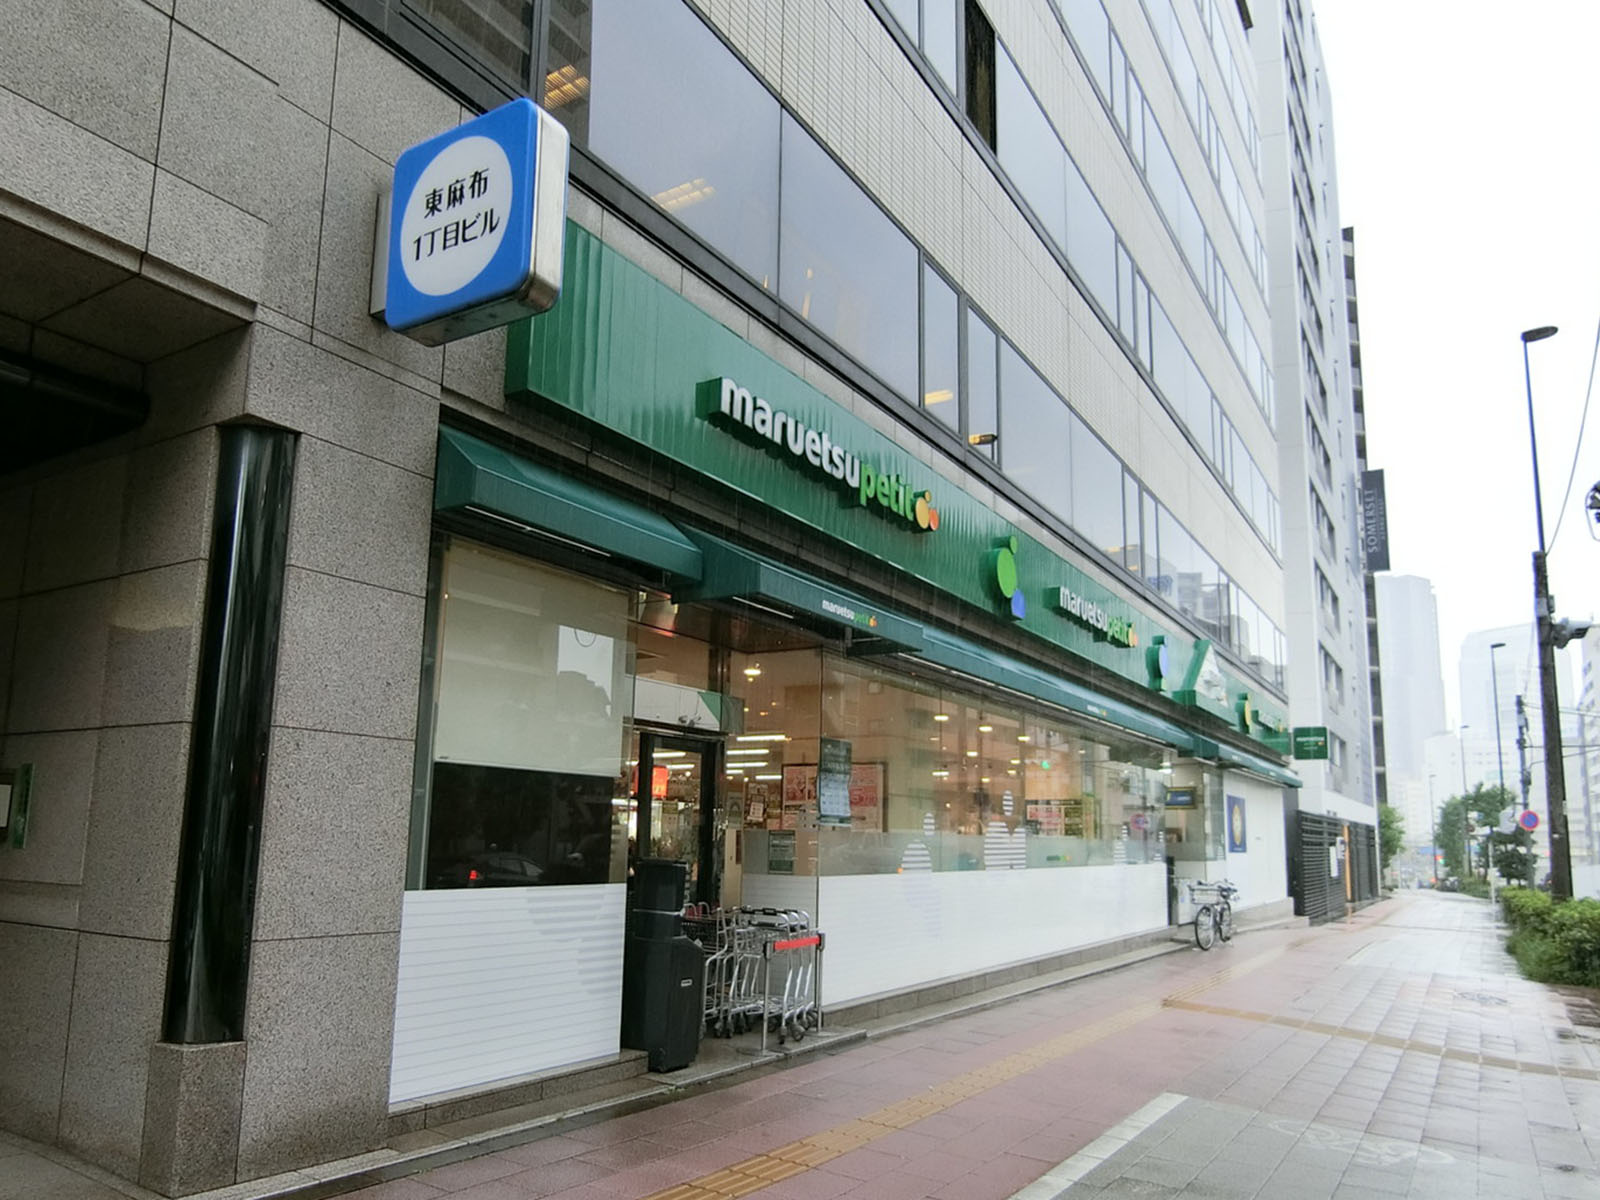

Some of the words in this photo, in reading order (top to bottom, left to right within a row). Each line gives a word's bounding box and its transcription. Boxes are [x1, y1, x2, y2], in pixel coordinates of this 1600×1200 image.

[424, 168, 490, 219] 東麻布
[413, 208, 500, 261] 1丁目ビル
[1364, 489, 1378, 553] SOMERSET
